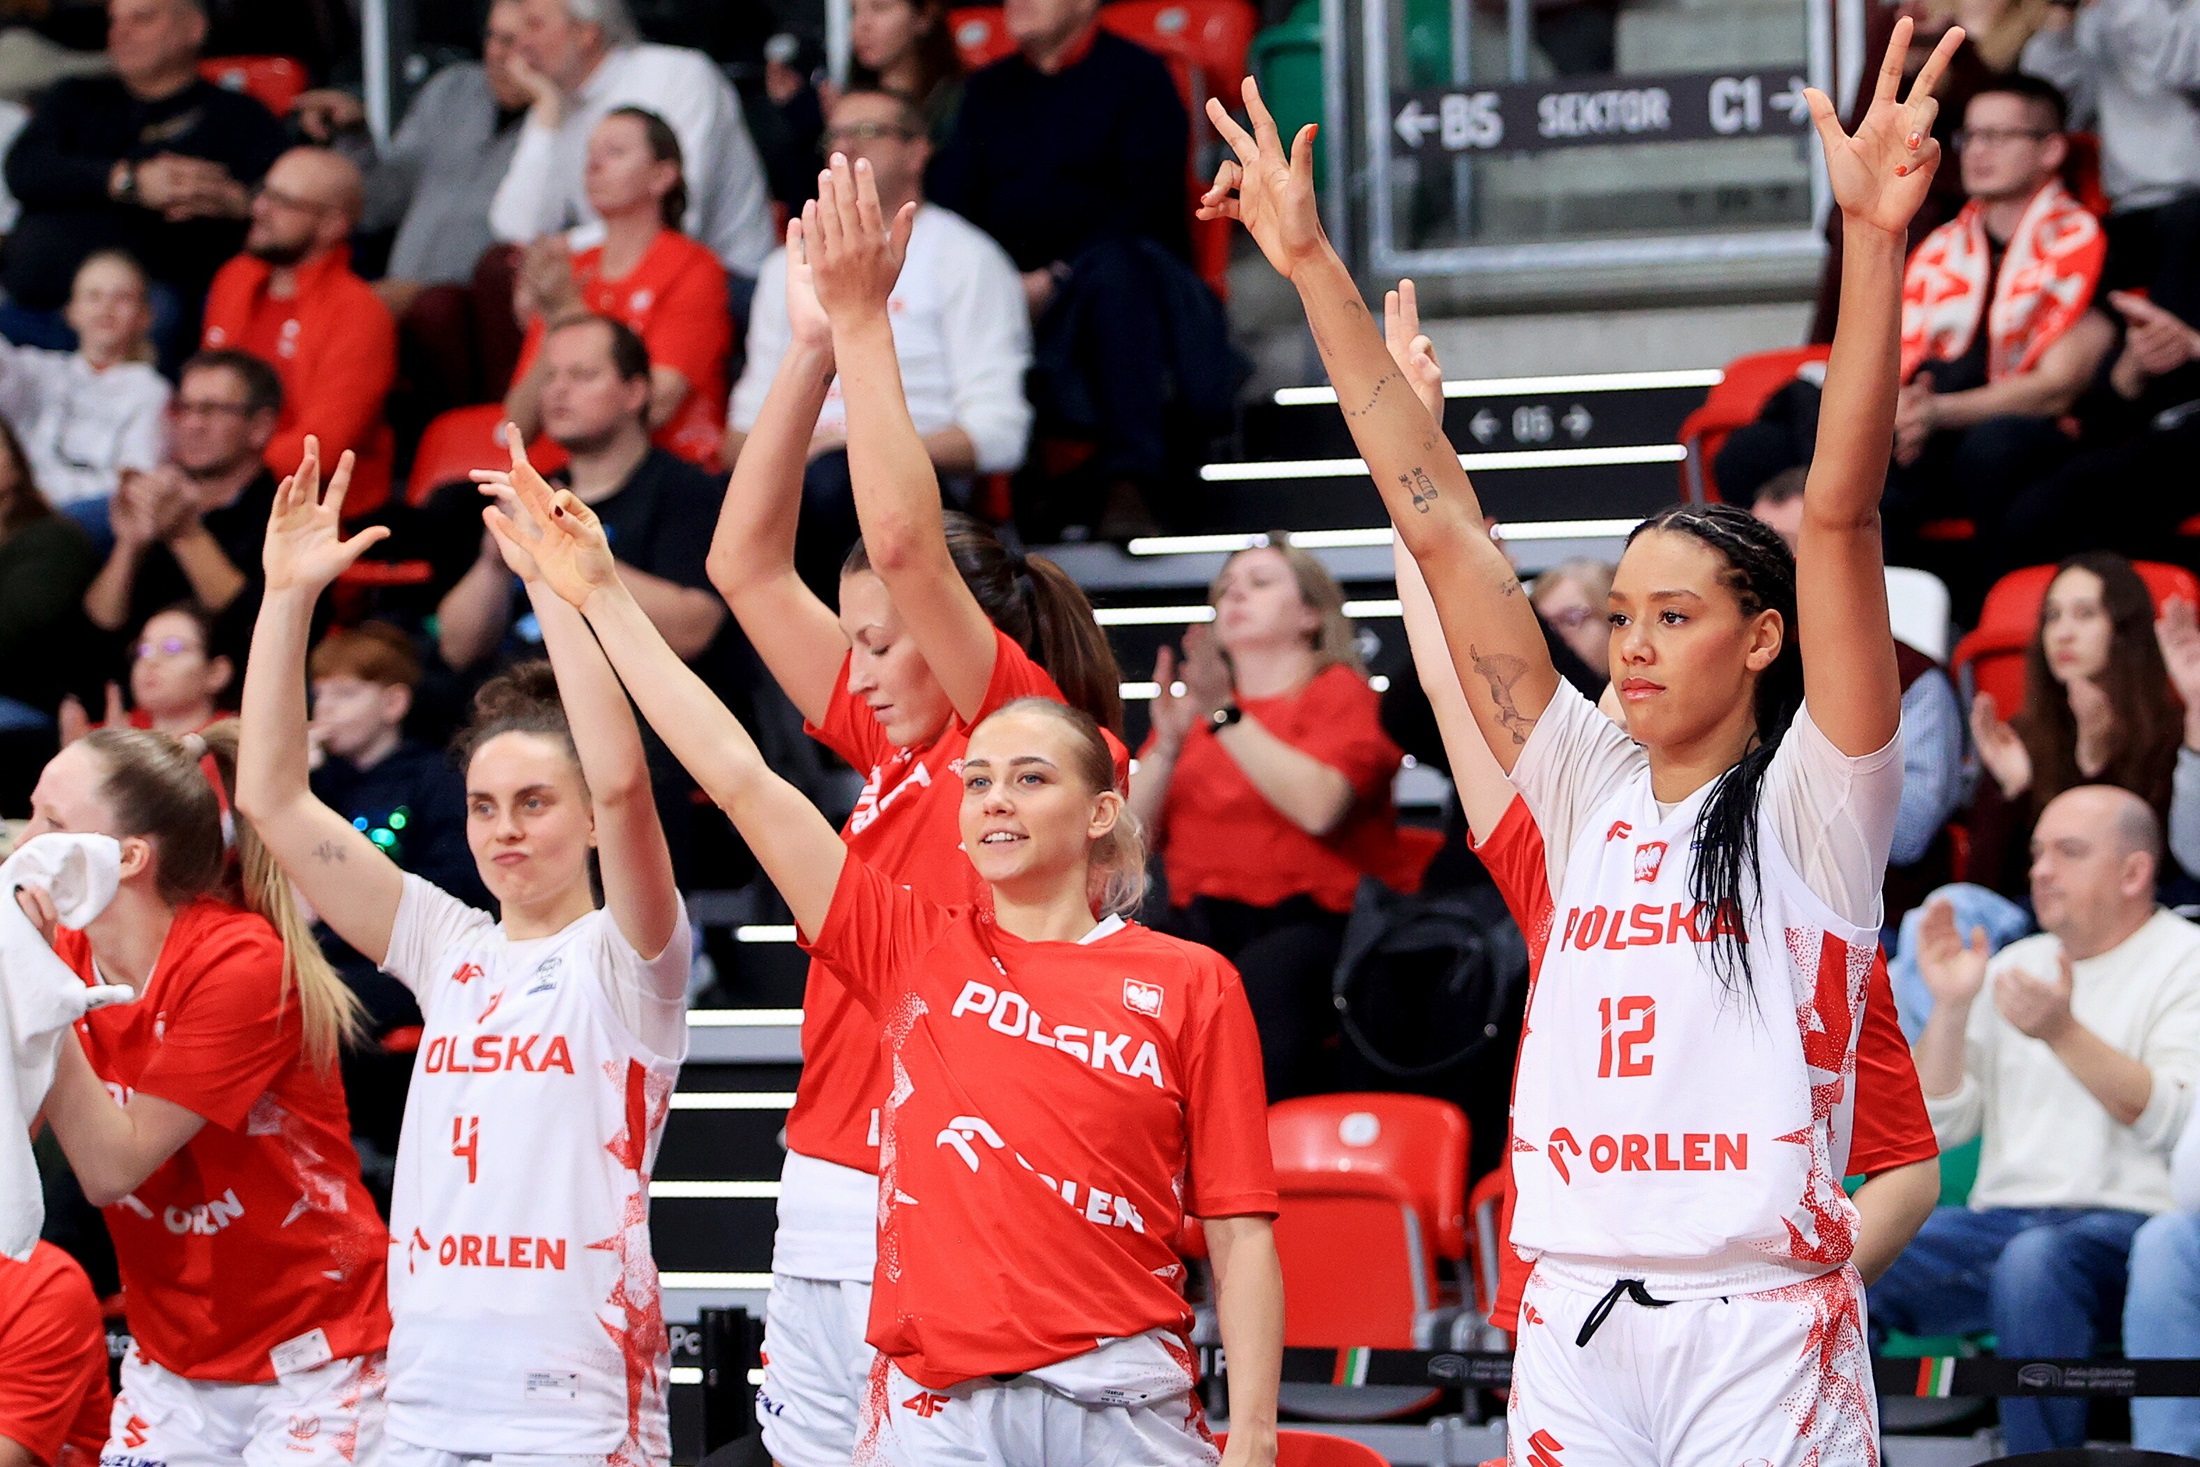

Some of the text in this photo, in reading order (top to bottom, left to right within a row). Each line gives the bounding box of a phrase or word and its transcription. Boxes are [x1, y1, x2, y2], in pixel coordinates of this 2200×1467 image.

[1537, 87, 1672, 138] SEKTOR
[1708, 76, 1762, 134] C1
[1560, 898, 1750, 952] POLSKA
[425, 1034, 575, 1075] OLSKA
[951, 980, 1164, 1089] POLSKA
[1597, 996, 1656, 1078] 12
[452, 1116, 479, 1184] 4
[1589, 1133, 1748, 1174] ORLEN
[439, 1234, 566, 1271] ORLEN
[902, 1391, 951, 1419] 4F
